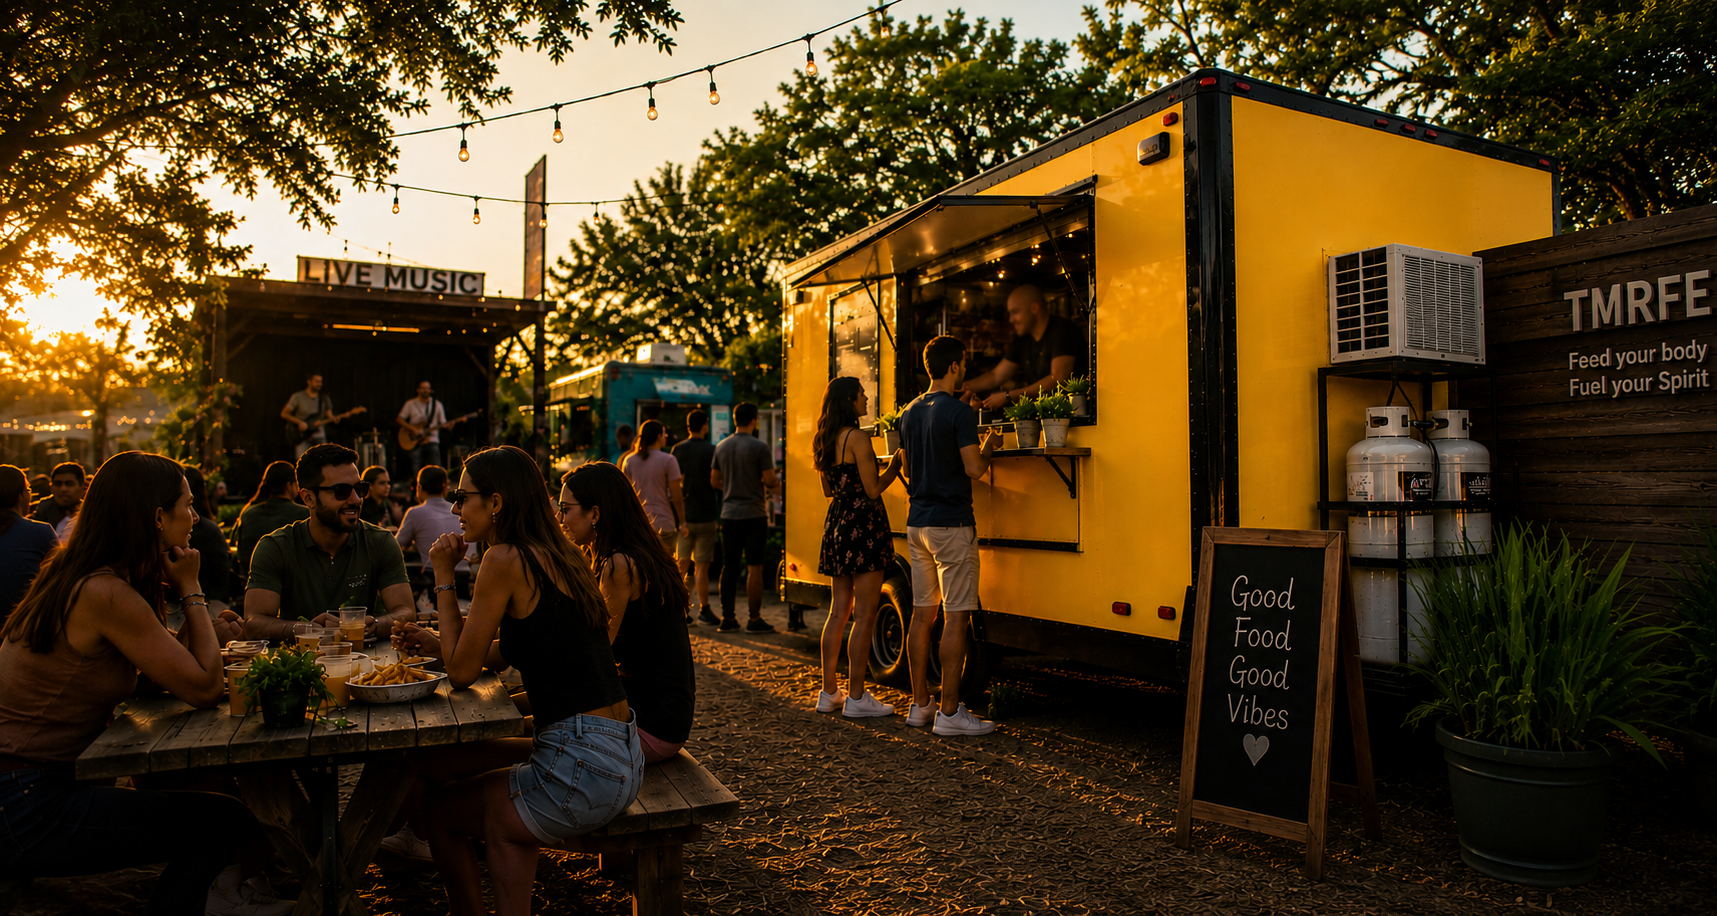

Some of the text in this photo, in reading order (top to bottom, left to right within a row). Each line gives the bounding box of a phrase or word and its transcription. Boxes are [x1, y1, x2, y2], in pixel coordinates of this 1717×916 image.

[304, 259, 477, 293] LIVE MUSIC
[1563, 269, 1712, 332] TMRFE
[1569, 339, 1708, 370] Feed your body
[1570, 368, 1710, 398] Fuel your Spirit
[1231, 575, 1295, 611] Good
[1234, 616, 1291, 651] Food
[1229, 655, 1289, 690] Good
[1228, 694, 1289, 730] Vibes
